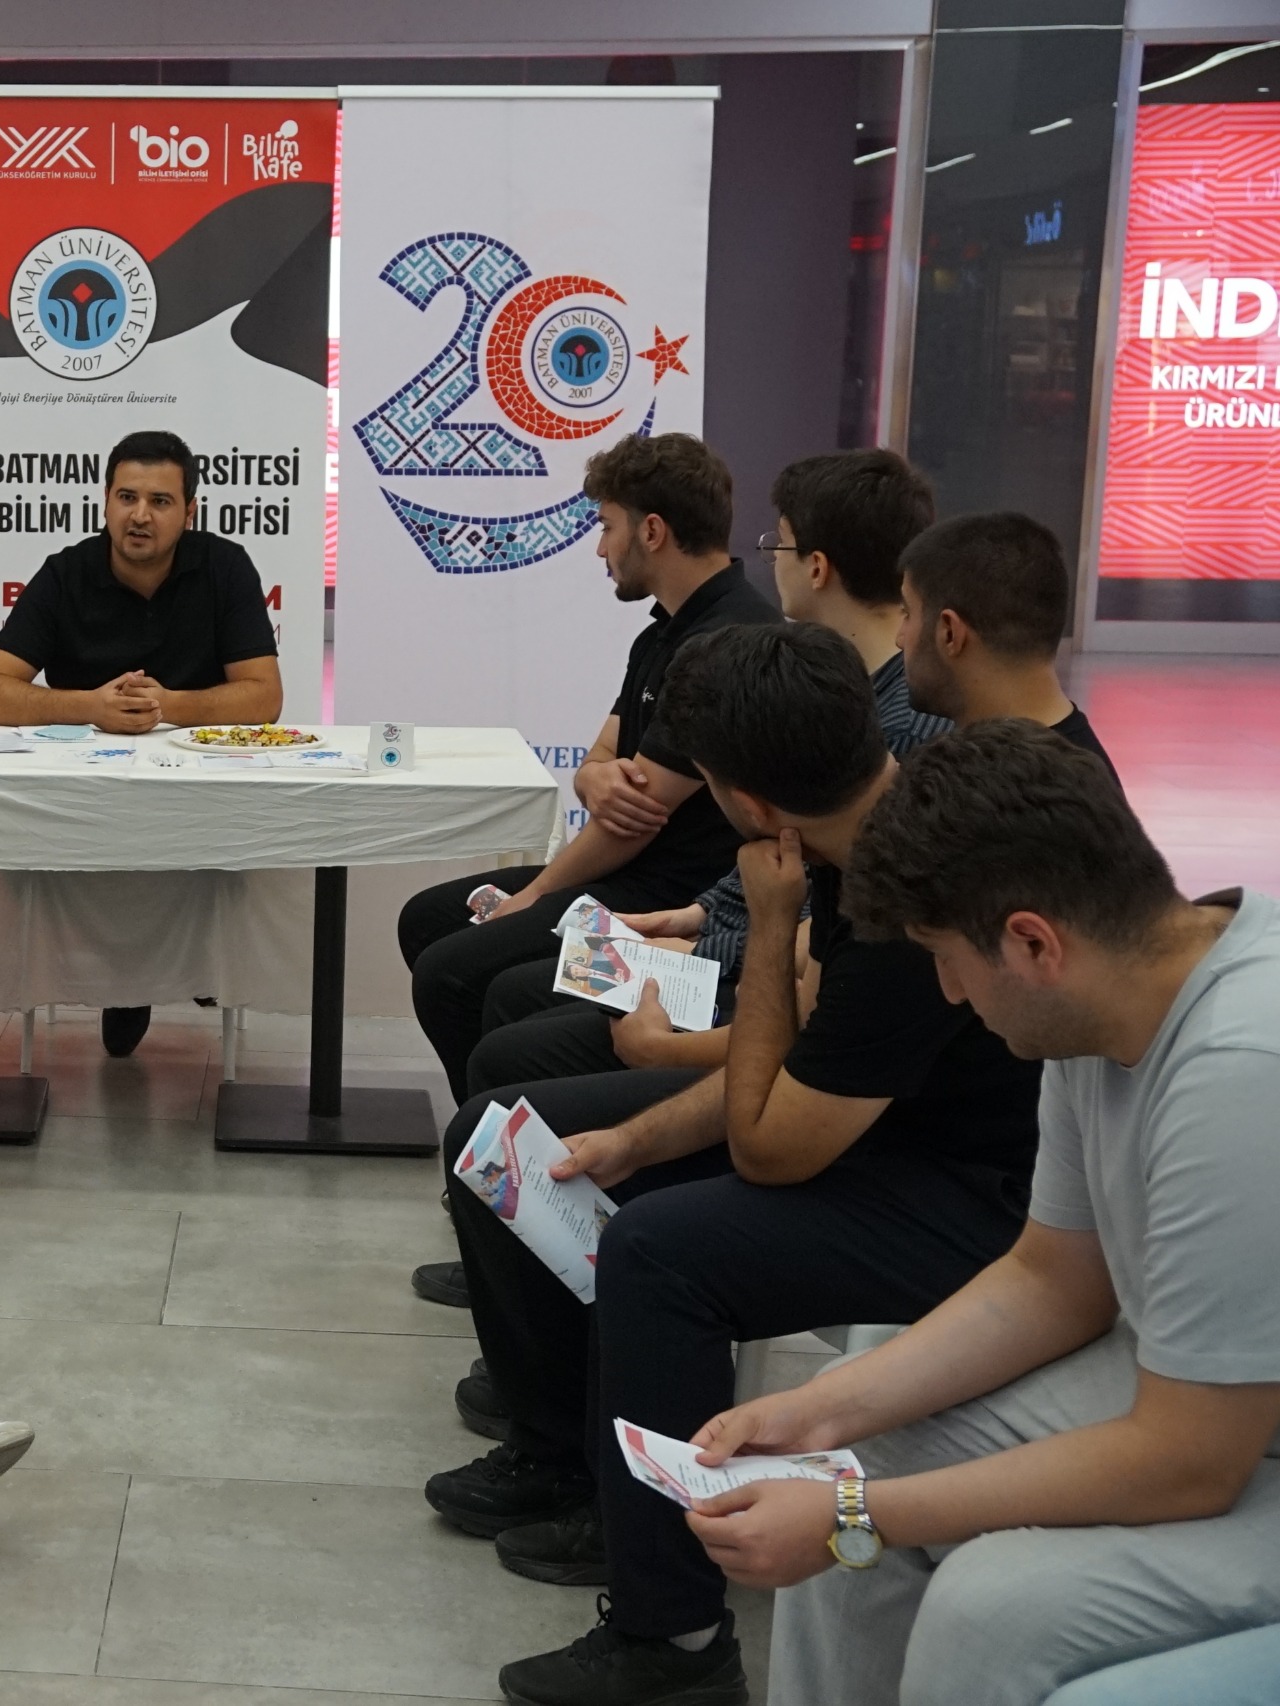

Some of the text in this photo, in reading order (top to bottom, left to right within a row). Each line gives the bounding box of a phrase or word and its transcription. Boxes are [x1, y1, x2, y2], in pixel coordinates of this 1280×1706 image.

[135, 125, 210, 168] bio
[243, 133, 299, 157] Bilim
[63, 171, 97, 179] KURULU
[138, 169, 158, 177] BİLİM
[190, 169, 208, 177] OFİSİ
[253, 151, 303, 180] Kafe
[17, 235, 152, 358] BATMAN ÜNİVERSİTESİ
[1139, 262, 1280, 339] İND
[61, 354, 102, 371] 2007
[537, 311, 625, 389] BATMAN ÜNİVERSİTESİ
[1151, 365, 1266, 390] KIRMIZI
[23, 392, 63, 405] Enerjiye
[66, 392, 123, 405] Dönüştüren
[126, 391, 177, 403] Üniversite
[568, 386, 593, 398] 2007
[219, 496, 290, 535] OFİSİ
